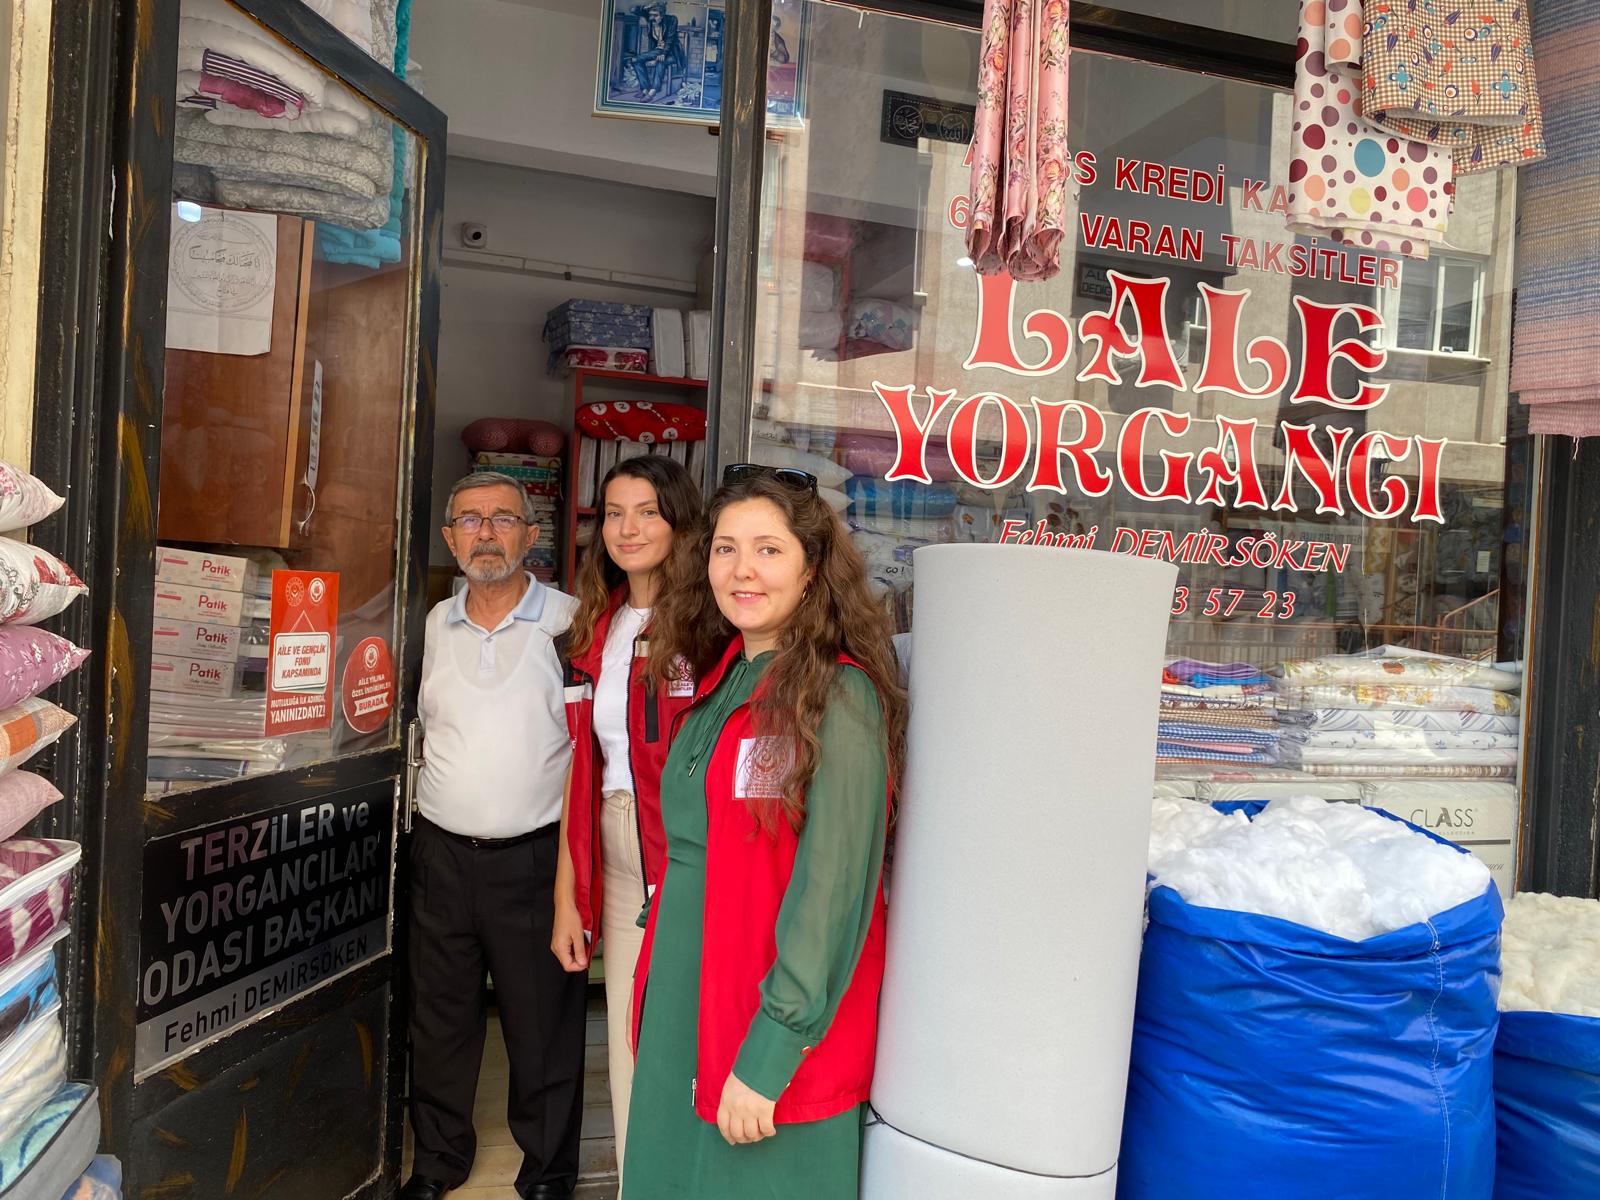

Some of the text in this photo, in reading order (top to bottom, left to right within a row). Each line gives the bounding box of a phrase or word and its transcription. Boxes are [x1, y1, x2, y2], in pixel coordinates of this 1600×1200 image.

[1114, 157, 1225, 205] KREDİ
[1079, 212, 1205, 262] VARAN
[1221, 233, 1402, 290] TAKSİTLER
[962, 269, 1391, 411] LALE
[871, 380, 1448, 524] YORGANCI
[201, 559, 232, 576] Patik
[198, 594, 229, 611] Patik
[1202, 587, 1244, 617] 57
[1257, 591, 1296, 619] 23
[196, 627, 229, 644] Patik
[277, 643, 326, 657] AİLE VE GENÇLİK
[189, 662, 221, 679] Patik
[281, 666, 321, 679] KAPSAMINDA
[270, 704, 325, 724] YANINIZDAYIZ!
[359, 697, 384, 711] BURADA
[342, 801, 370, 831] ve
[1410, 807, 1474, 828] CLASS
[143, 875, 384, 1006] ODASI BAŞKANI
[164, 933, 369, 1053] Fehmi DEMİRSÖKEN
